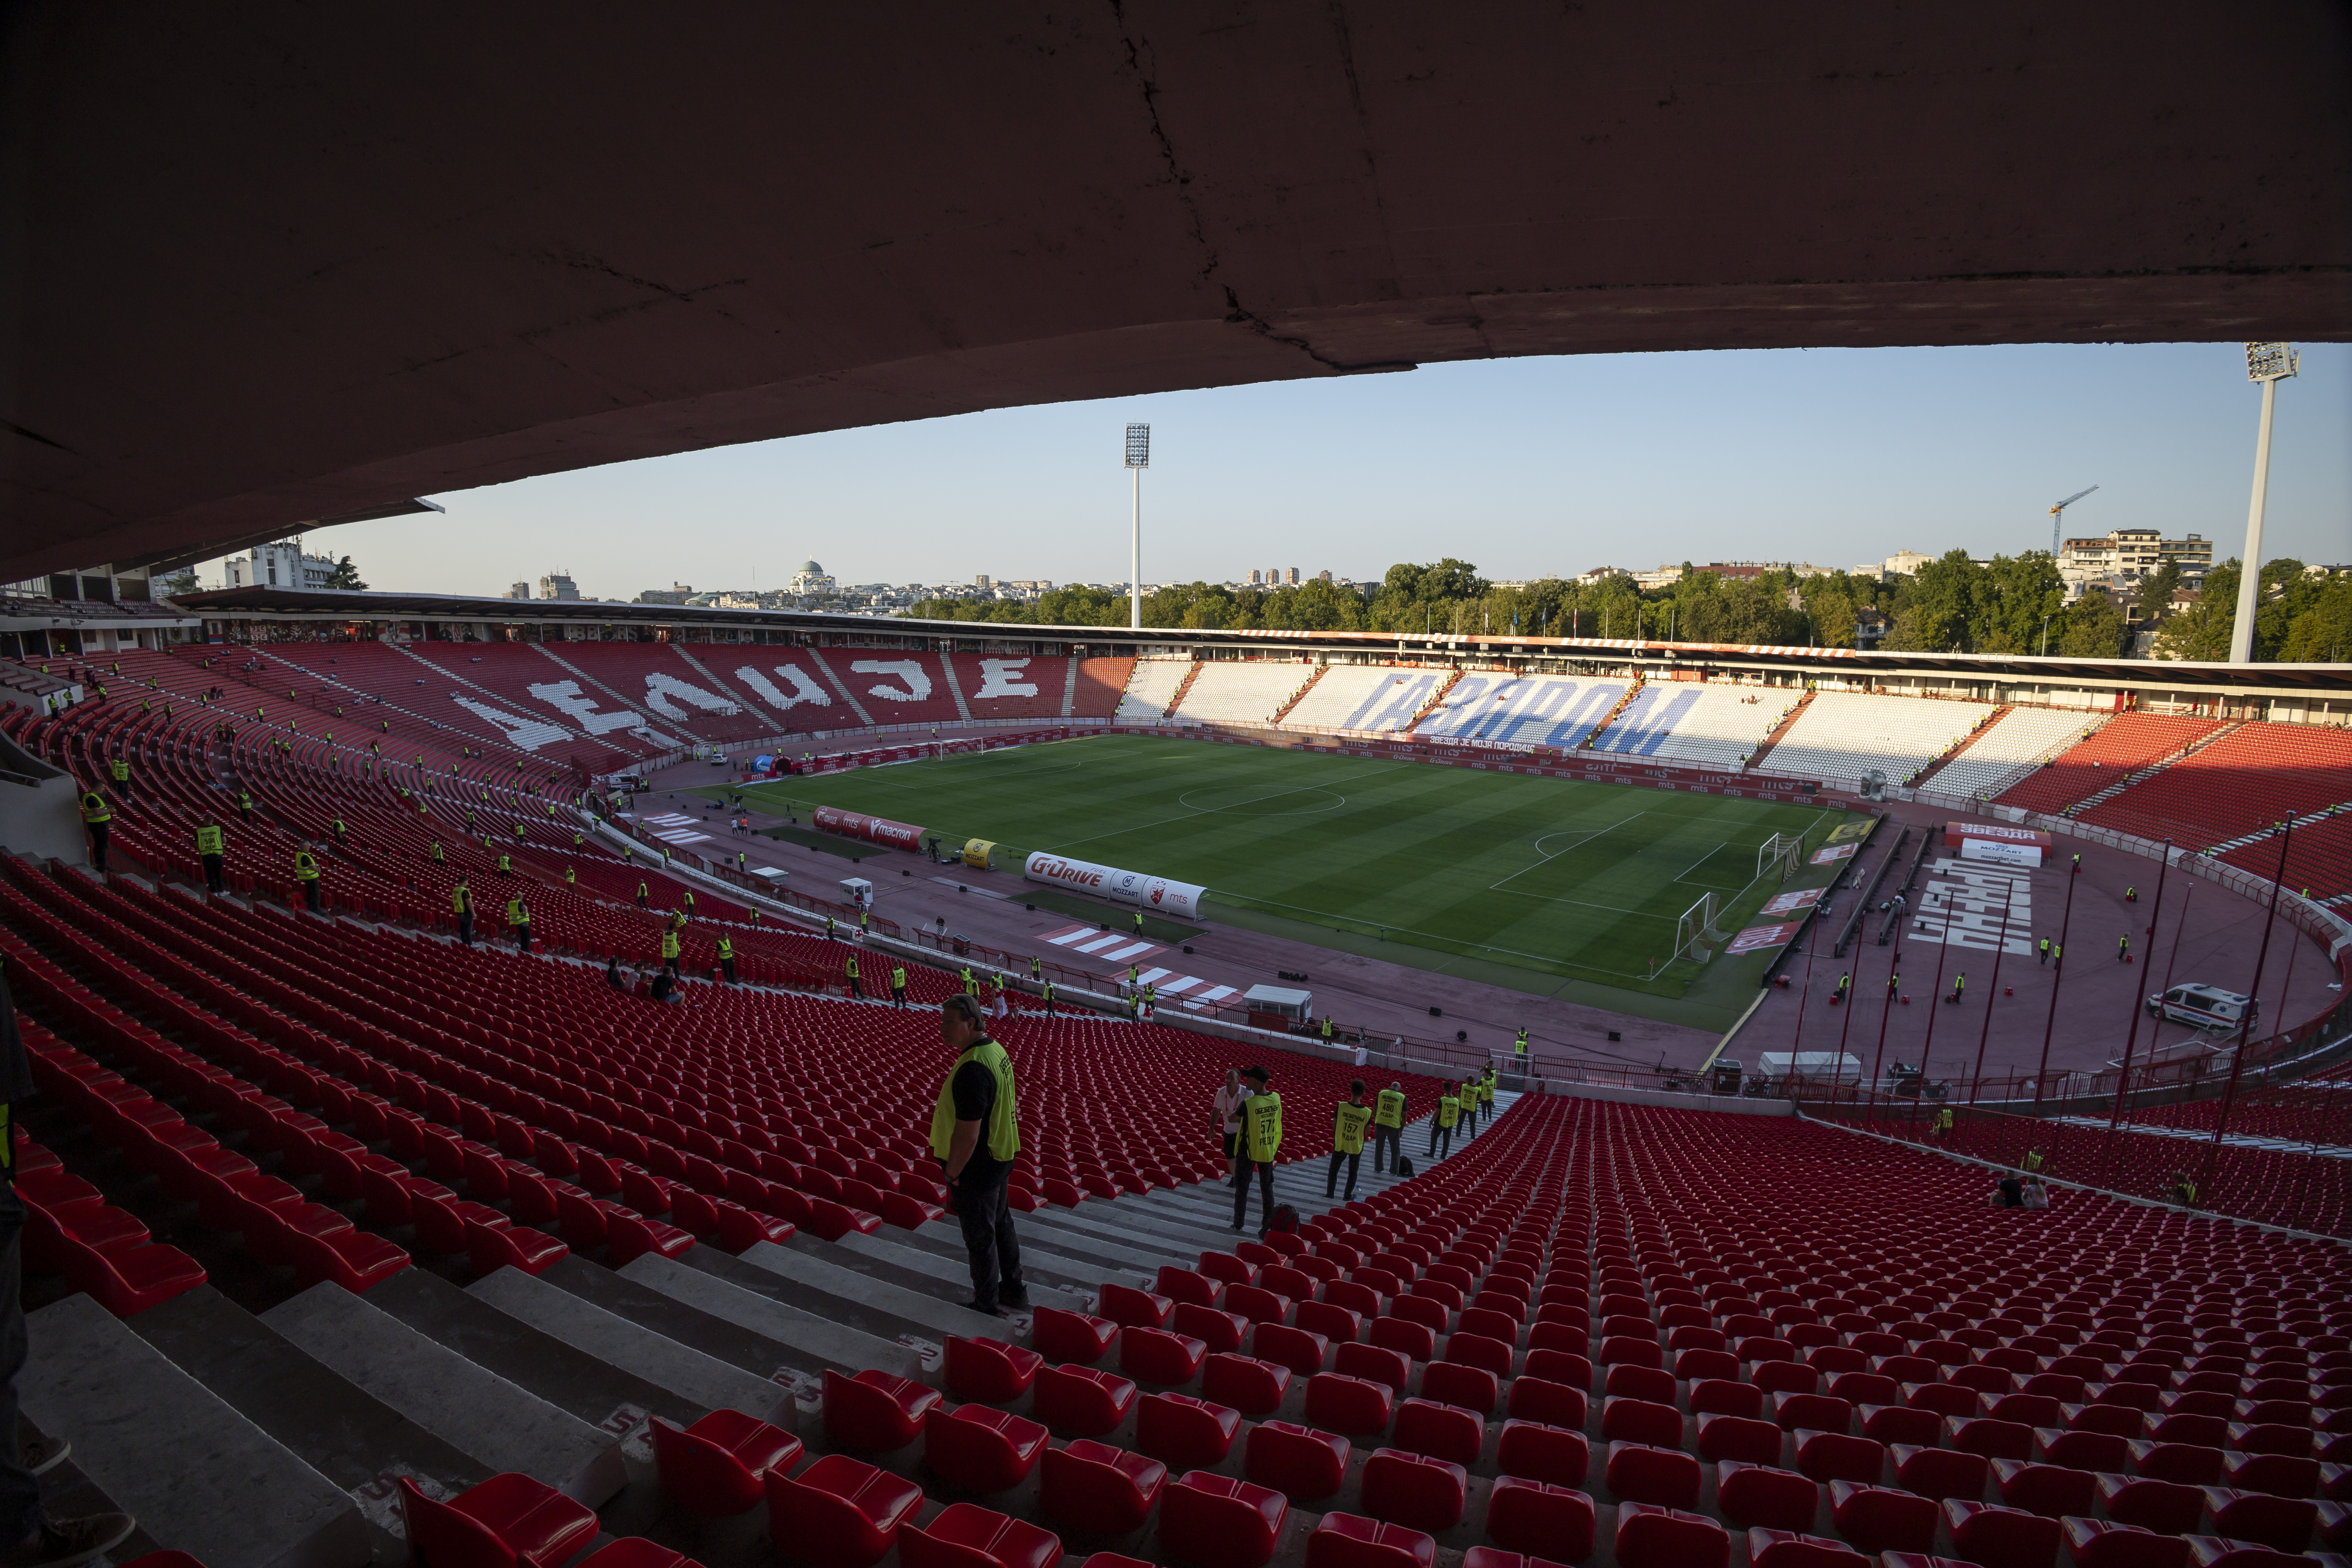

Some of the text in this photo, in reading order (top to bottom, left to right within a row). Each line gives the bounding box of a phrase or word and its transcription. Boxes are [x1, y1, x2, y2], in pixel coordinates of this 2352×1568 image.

[1430, 736, 1459, 746] ЗВЕЗДА
[1758, 792, 1777, 800] mts
[1829, 800, 1846, 809] mts
[1871, 808, 1882, 816] mts
[843, 818, 858, 829] mts
[878, 824, 911, 841] macron
[1960, 826, 2036, 840] ЗВЕЗДА
[1980, 846, 2023, 855] MOZZART
[965, 853, 985, 862] MOZZART
[1981, 854, 2021, 863] mozzartbet.com
[1112, 886, 1139, 898] MOZZART
[1169, 893, 1188, 904] mts
[2183, 1012, 2211, 1023] AMBULANCE
[1382, 1103, 1394, 1112] 480
[1344, 1122, 1358, 1133] 157
[1259, 1136, 1275, 1146] РЕДА
